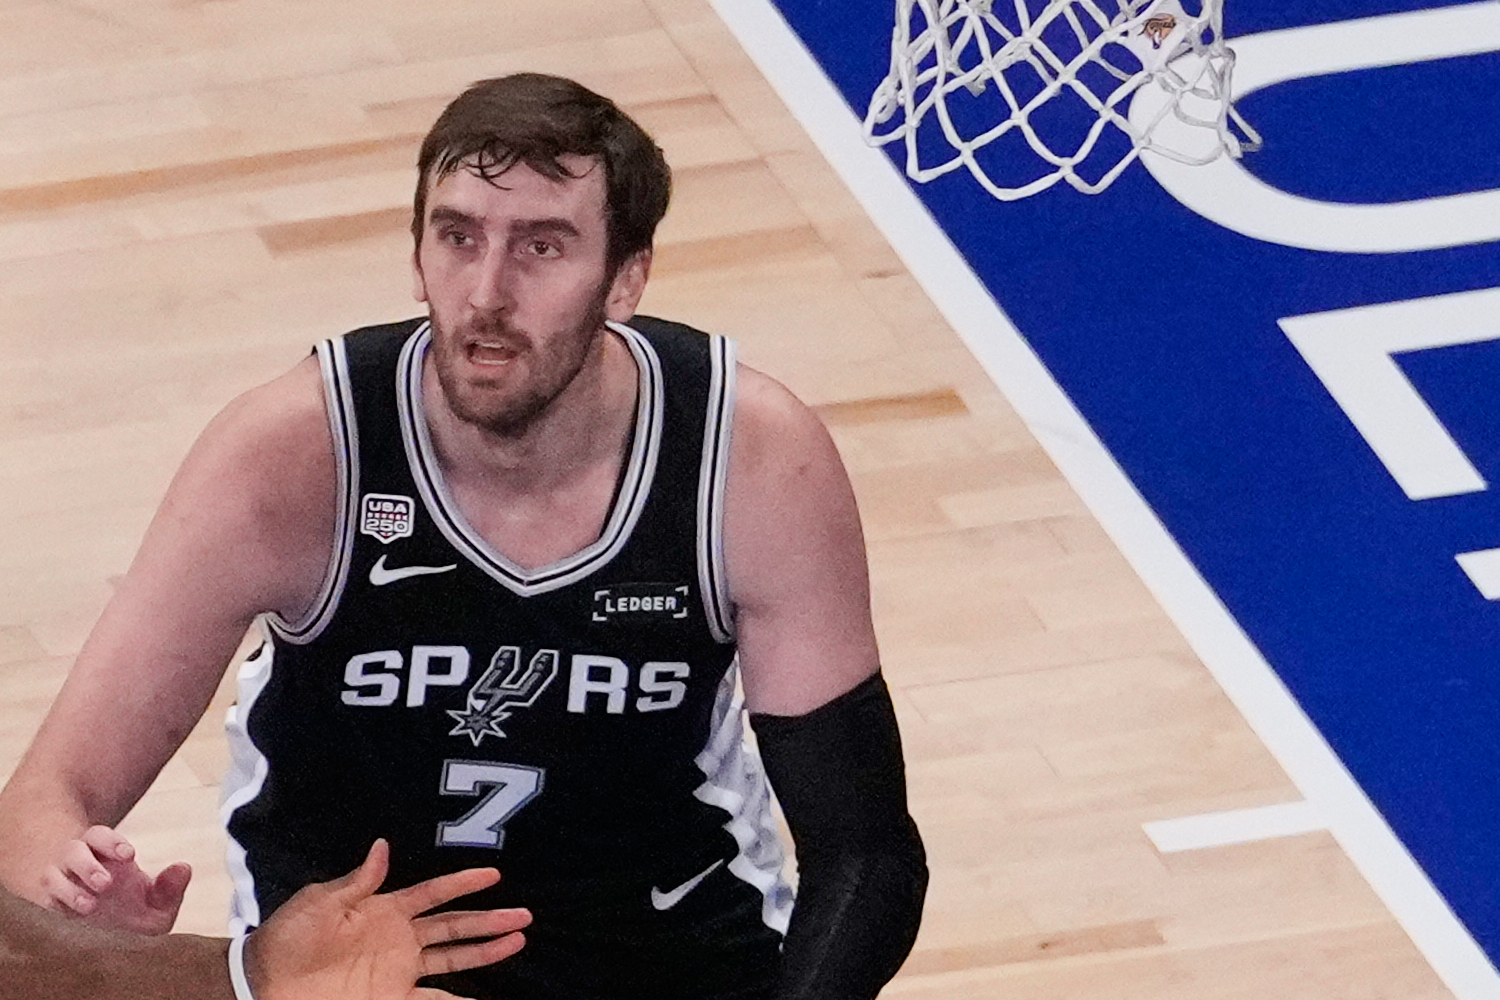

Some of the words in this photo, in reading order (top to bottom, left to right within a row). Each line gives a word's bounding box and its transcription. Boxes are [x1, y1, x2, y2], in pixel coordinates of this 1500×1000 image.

[368, 500, 408, 514] USA
[366, 518, 408, 533] 250
[605, 595, 677, 613] LEDGER
[435, 758, 546, 850] 7
